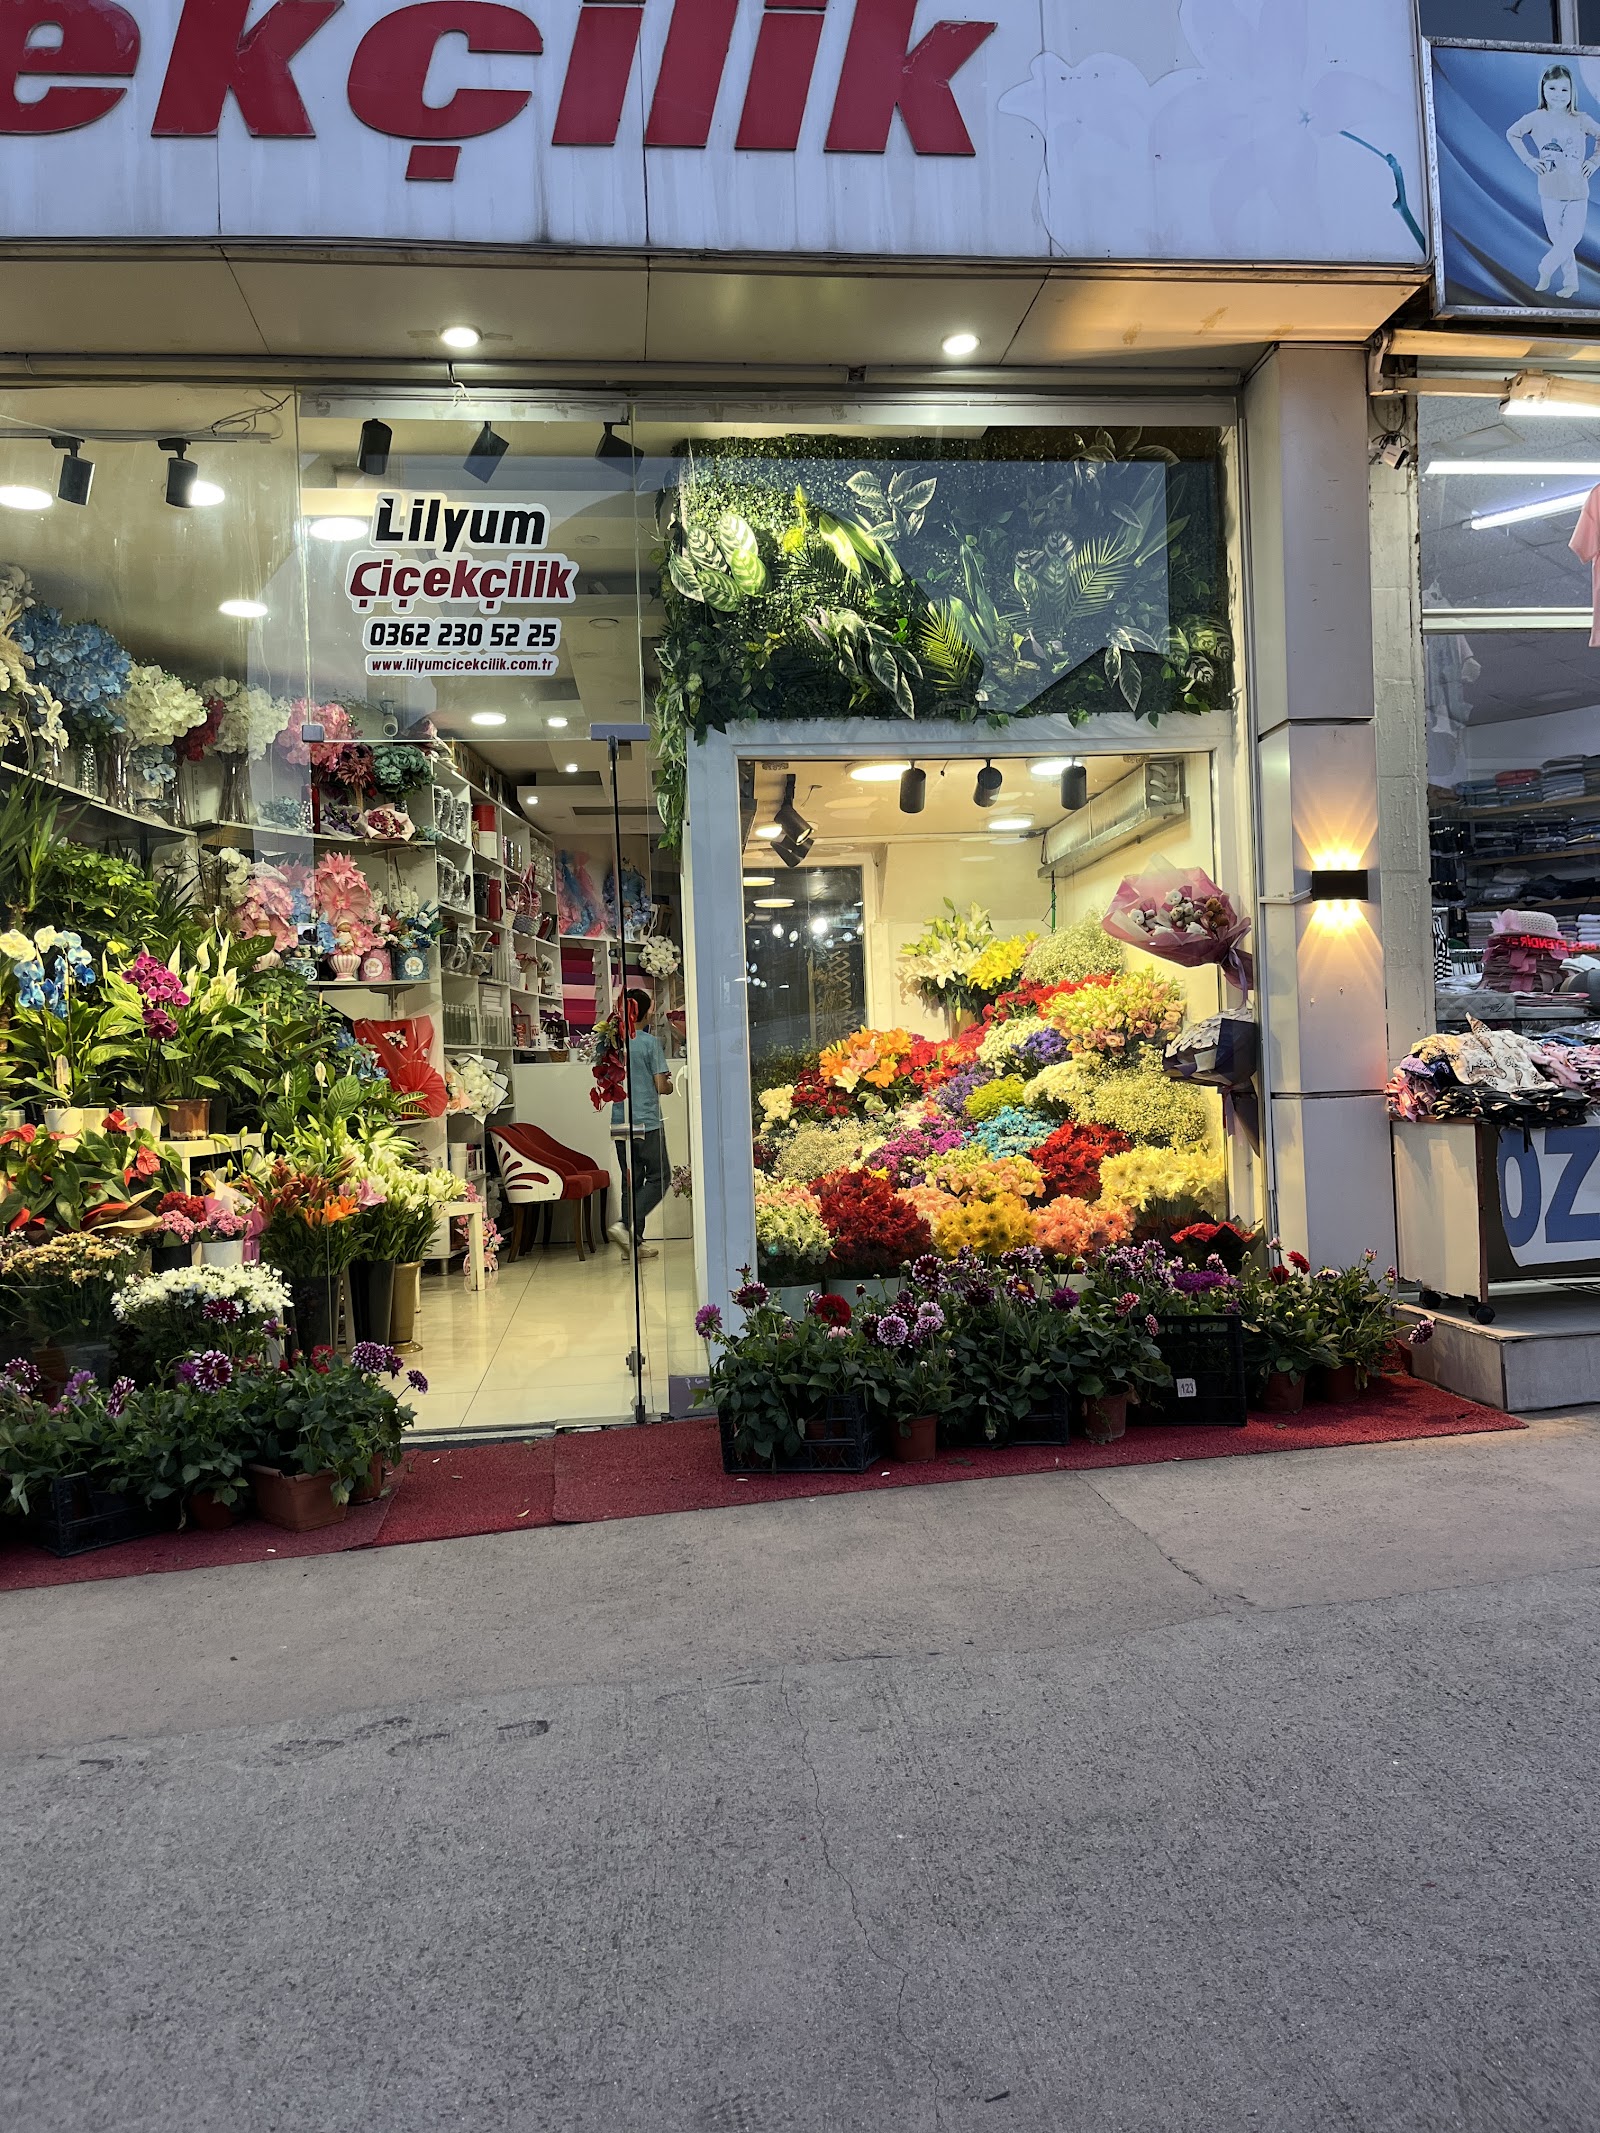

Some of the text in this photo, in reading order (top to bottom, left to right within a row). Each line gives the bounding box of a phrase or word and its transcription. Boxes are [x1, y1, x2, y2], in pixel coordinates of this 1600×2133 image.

[0, 0, 998, 182] ekçilik
[375, 498, 545, 552] Lilyum
[349, 558, 572, 609] Çiçekçilik
[370, 623, 557, 647] 0362 230 52 25
[372, 657, 553, 674] www.lilyumcicekcilik.com.tr
